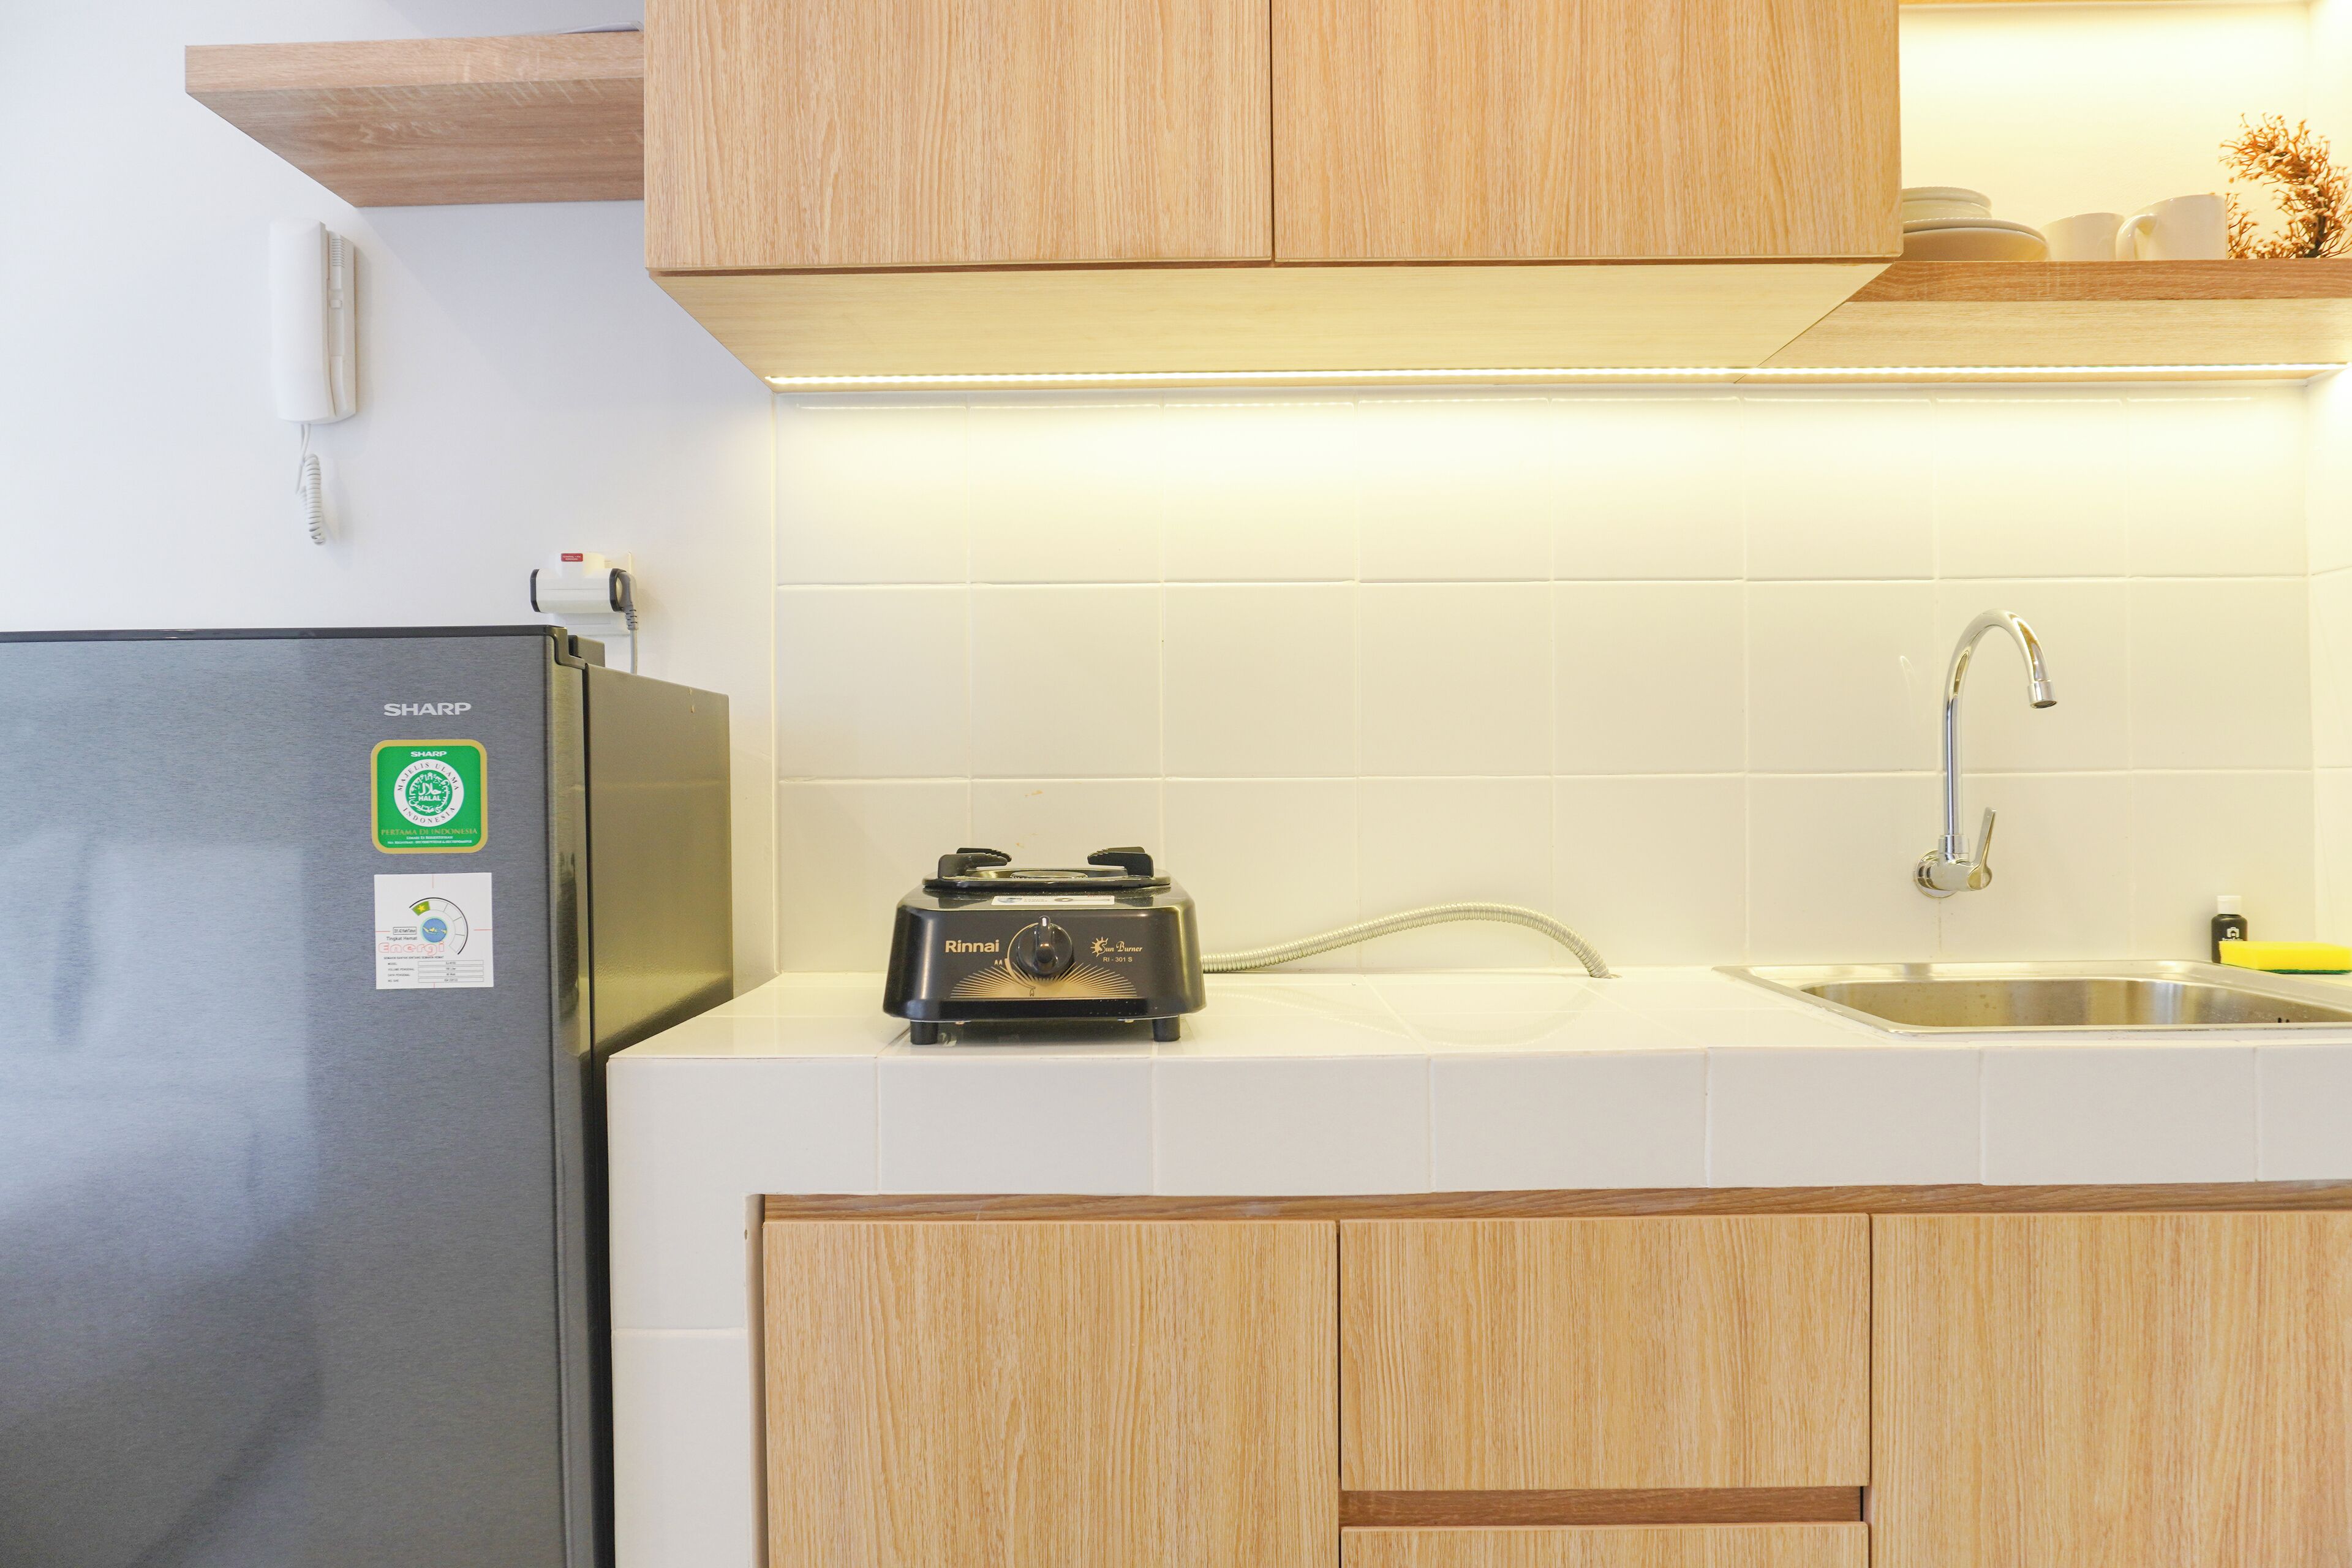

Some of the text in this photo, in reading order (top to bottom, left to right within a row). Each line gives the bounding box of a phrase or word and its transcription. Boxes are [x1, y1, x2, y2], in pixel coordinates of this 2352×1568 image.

[384, 702, 471, 717] SHARP
[397, 762, 459, 792] MAJELIS ULAMA
[402, 807, 456, 824] INDONESIA
[378, 941, 445, 956] Energi
[945, 939, 1000, 953] Rinnai
[1098, 941, 1143, 954] Sun Burner
